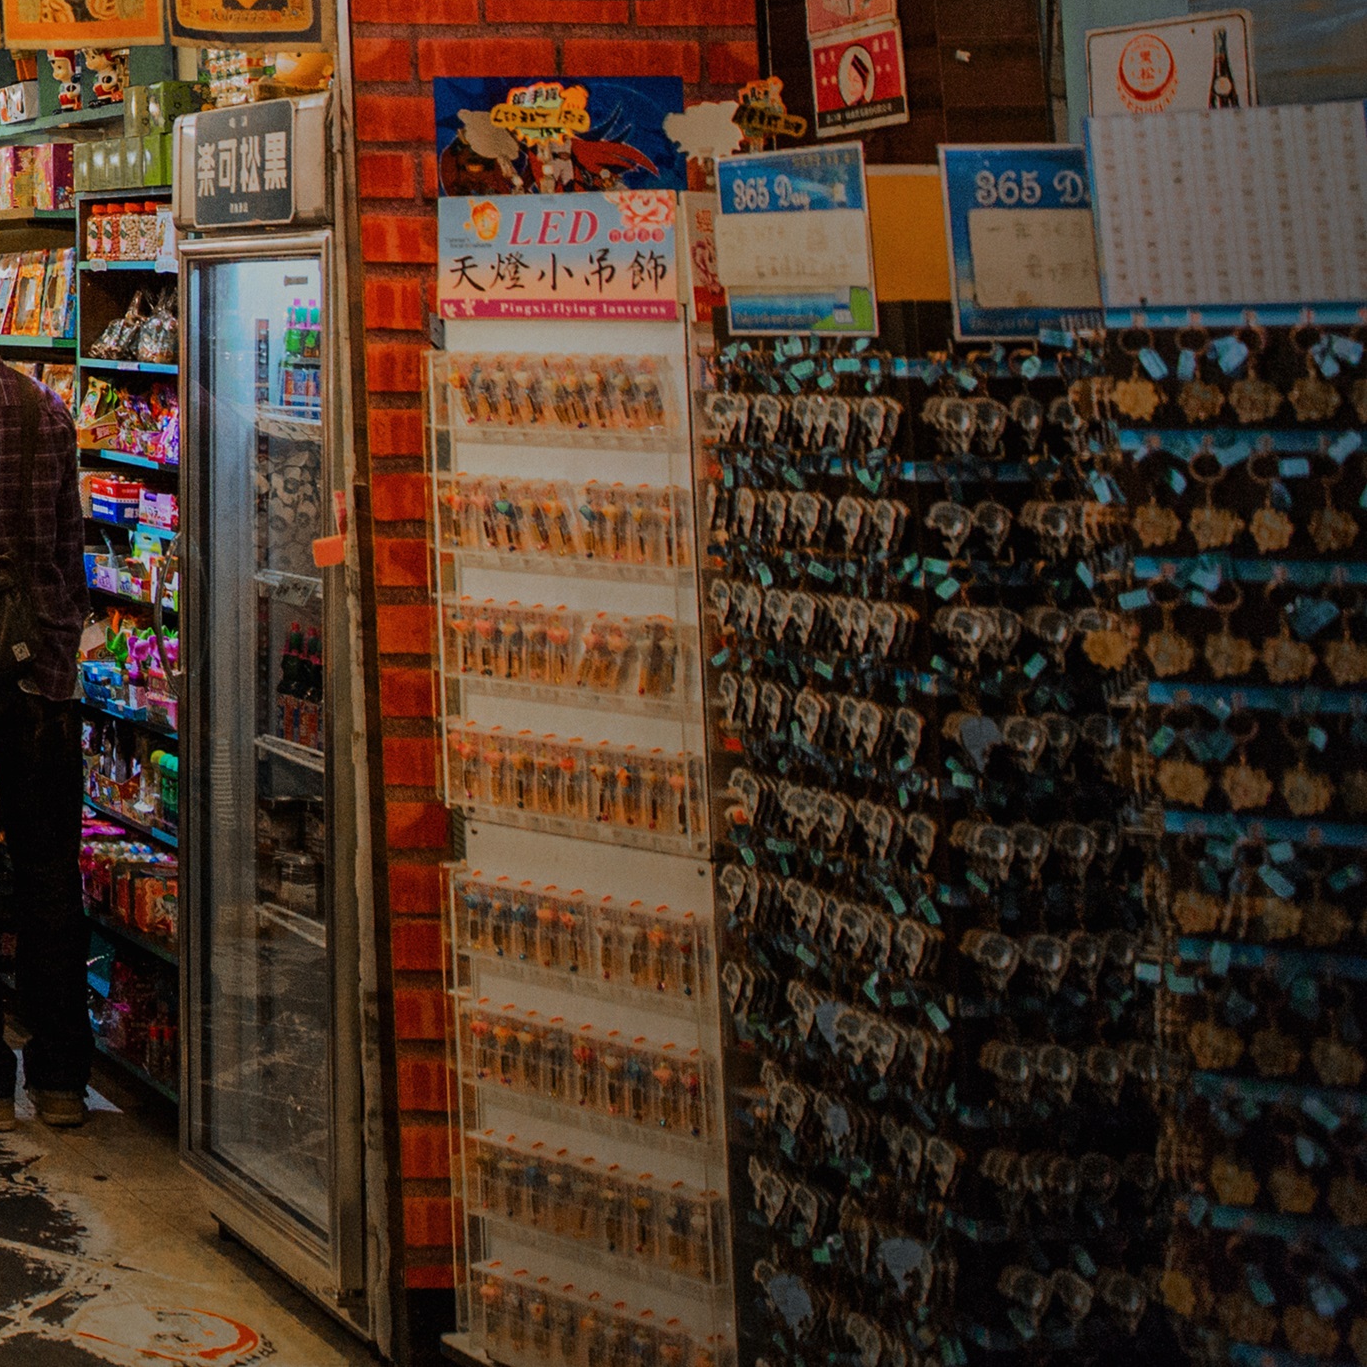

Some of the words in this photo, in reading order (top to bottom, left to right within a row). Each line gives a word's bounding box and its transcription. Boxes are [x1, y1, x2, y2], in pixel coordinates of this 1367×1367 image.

[732, 178, 770, 211] 365
[974, 169, 1043, 207] 365
[508, 209, 600, 246] LED
[449, 248, 668, 293] 天燈小吊飾
